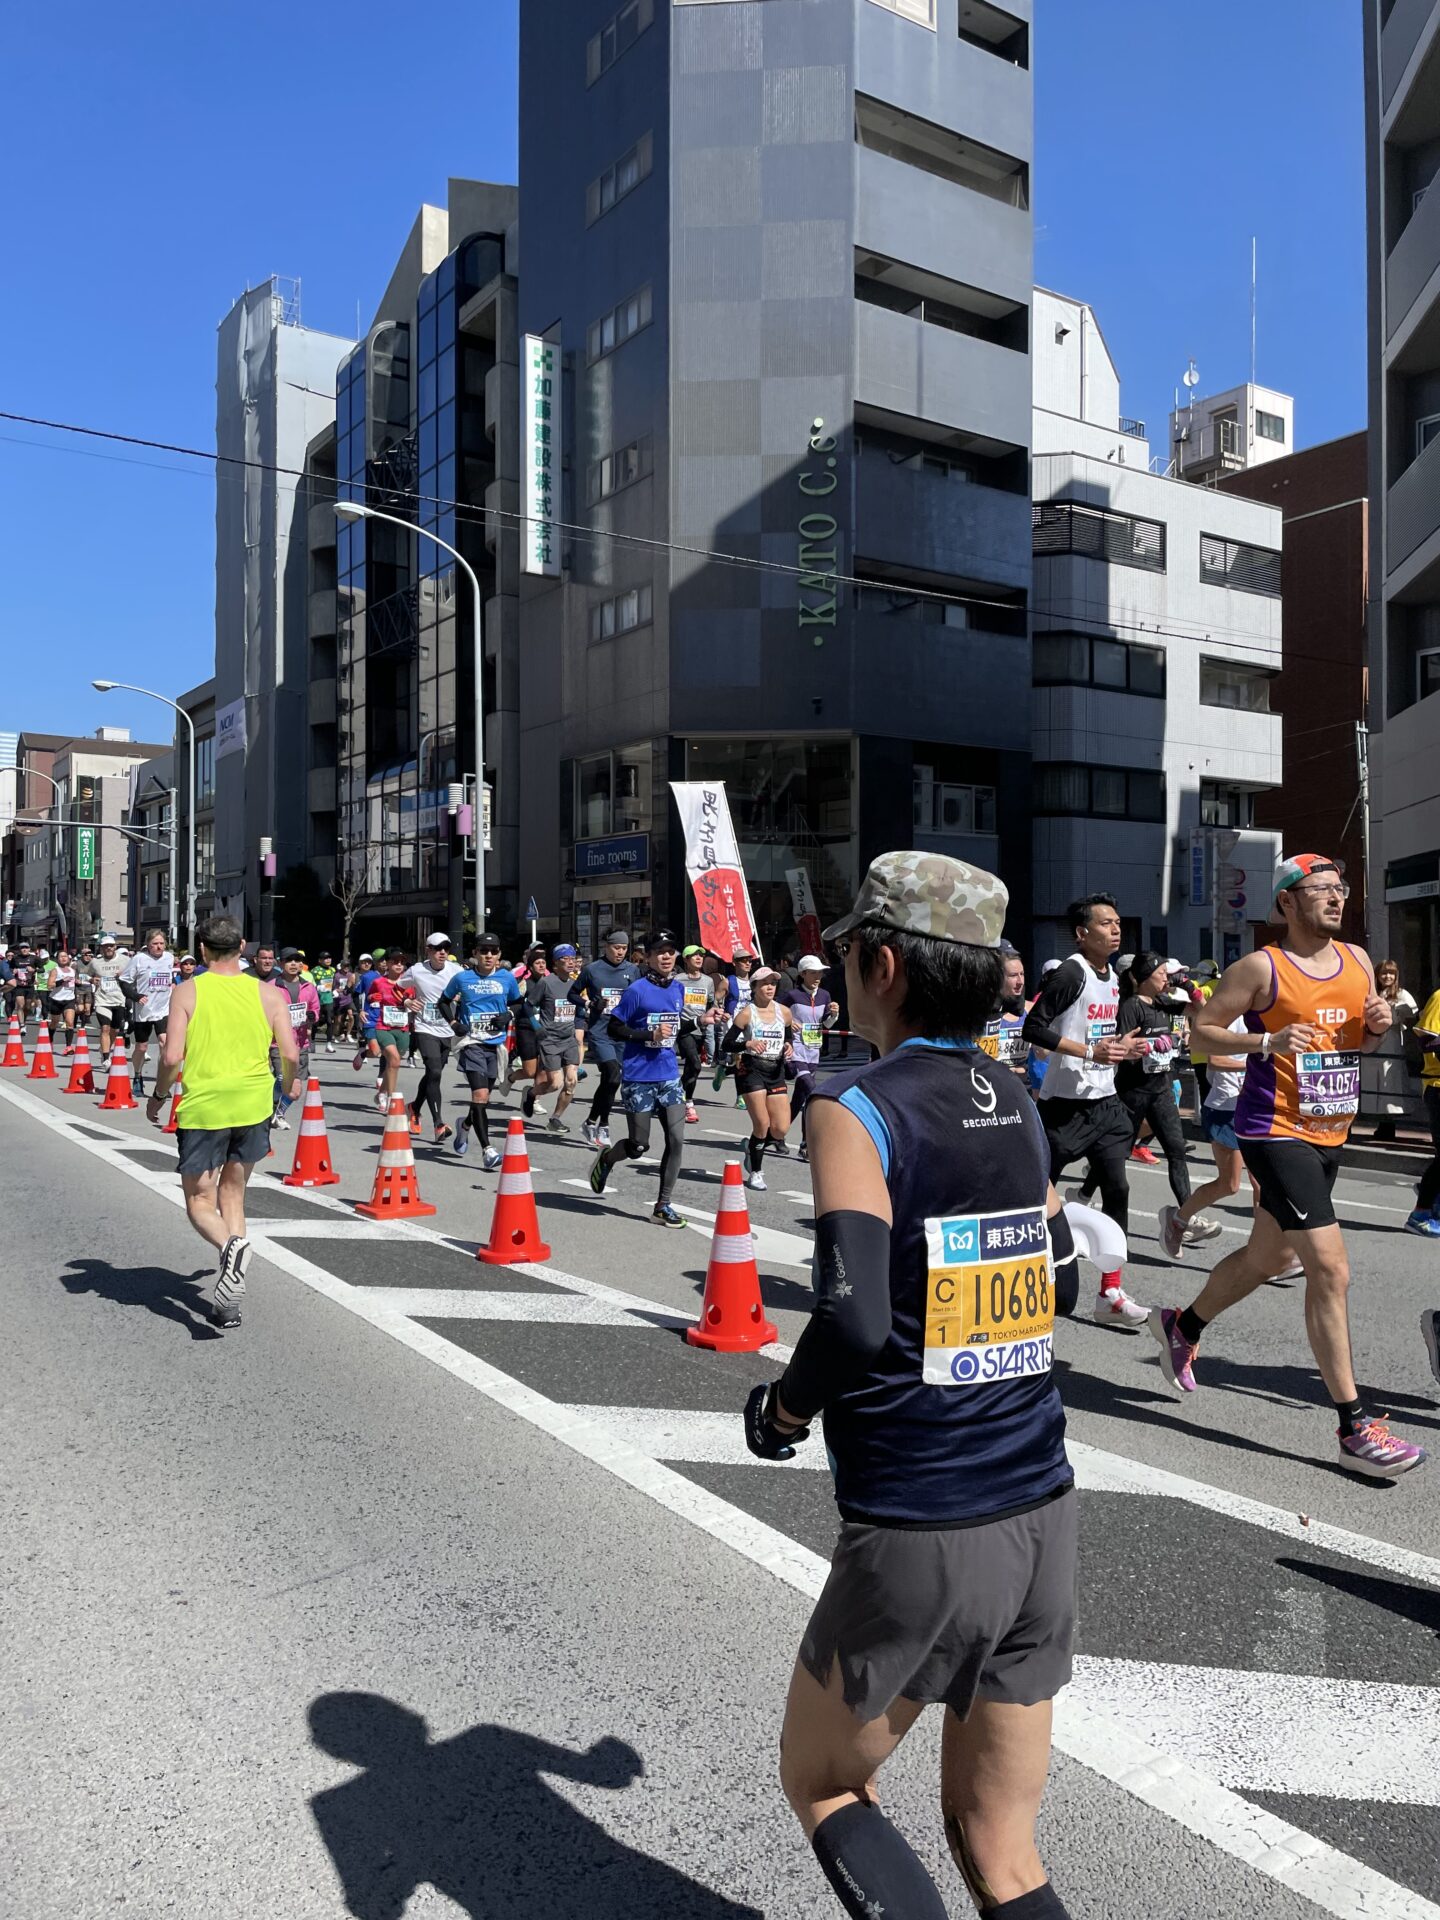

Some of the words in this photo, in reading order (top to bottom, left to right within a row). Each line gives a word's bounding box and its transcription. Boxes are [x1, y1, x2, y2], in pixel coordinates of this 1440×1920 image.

[534, 374, 552, 564] 加藤建設株式会社
[798, 513, 837, 627] KATO
[82, 838, 91, 877] モスバーガー
[587, 849, 605, 866] fine
[608, 849, 637, 864] rooms
[1316, 1008, 1347, 1024] TED
[1324, 1055, 1359, 1066] 東京メトロ
[963, 1112, 997, 1128] second
[1000, 1109, 1022, 1126] wind
[986, 1222, 1044, 1249] 東京メトロ
[935, 1278, 955, 1304] C
[974, 1264, 1048, 1326] 10688
[937, 1325, 946, 1345] 1
[993, 1329, 1018, 1340] TOKYO
